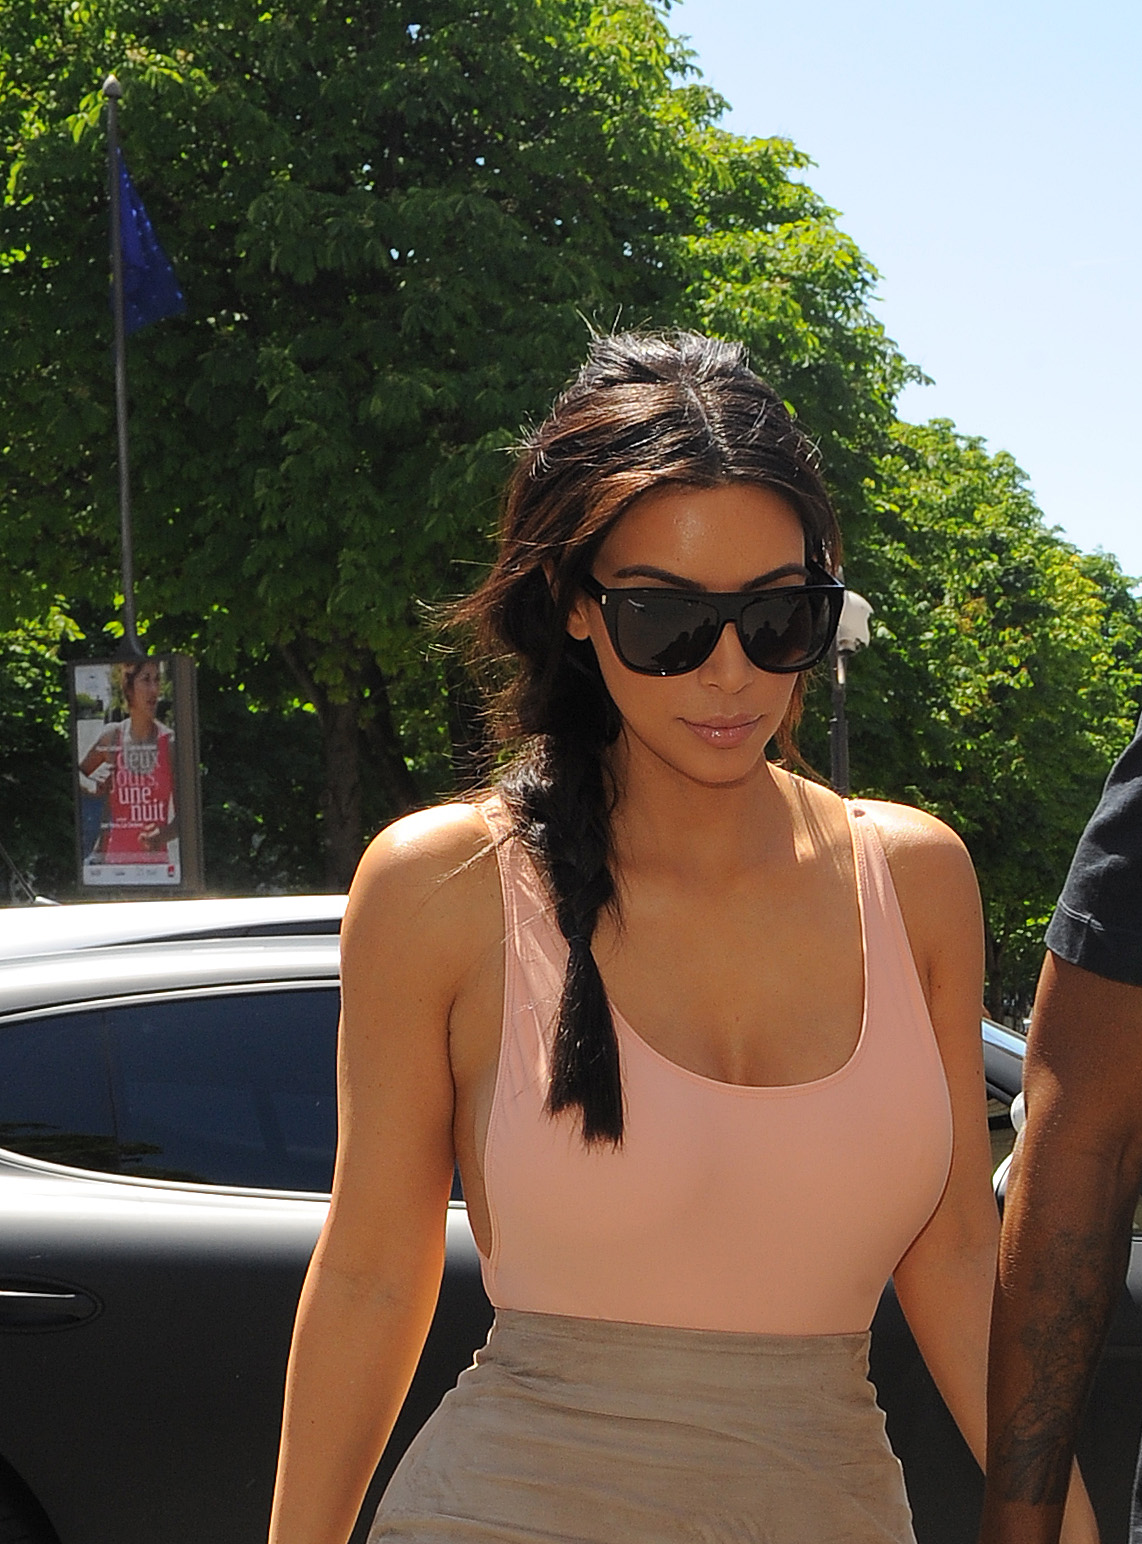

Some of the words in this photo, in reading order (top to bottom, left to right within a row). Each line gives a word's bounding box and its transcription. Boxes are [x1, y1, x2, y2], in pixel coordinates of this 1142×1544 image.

[117, 745, 161, 770] deux
[118, 786, 152, 805] une
[131, 798, 165, 822] nuit
